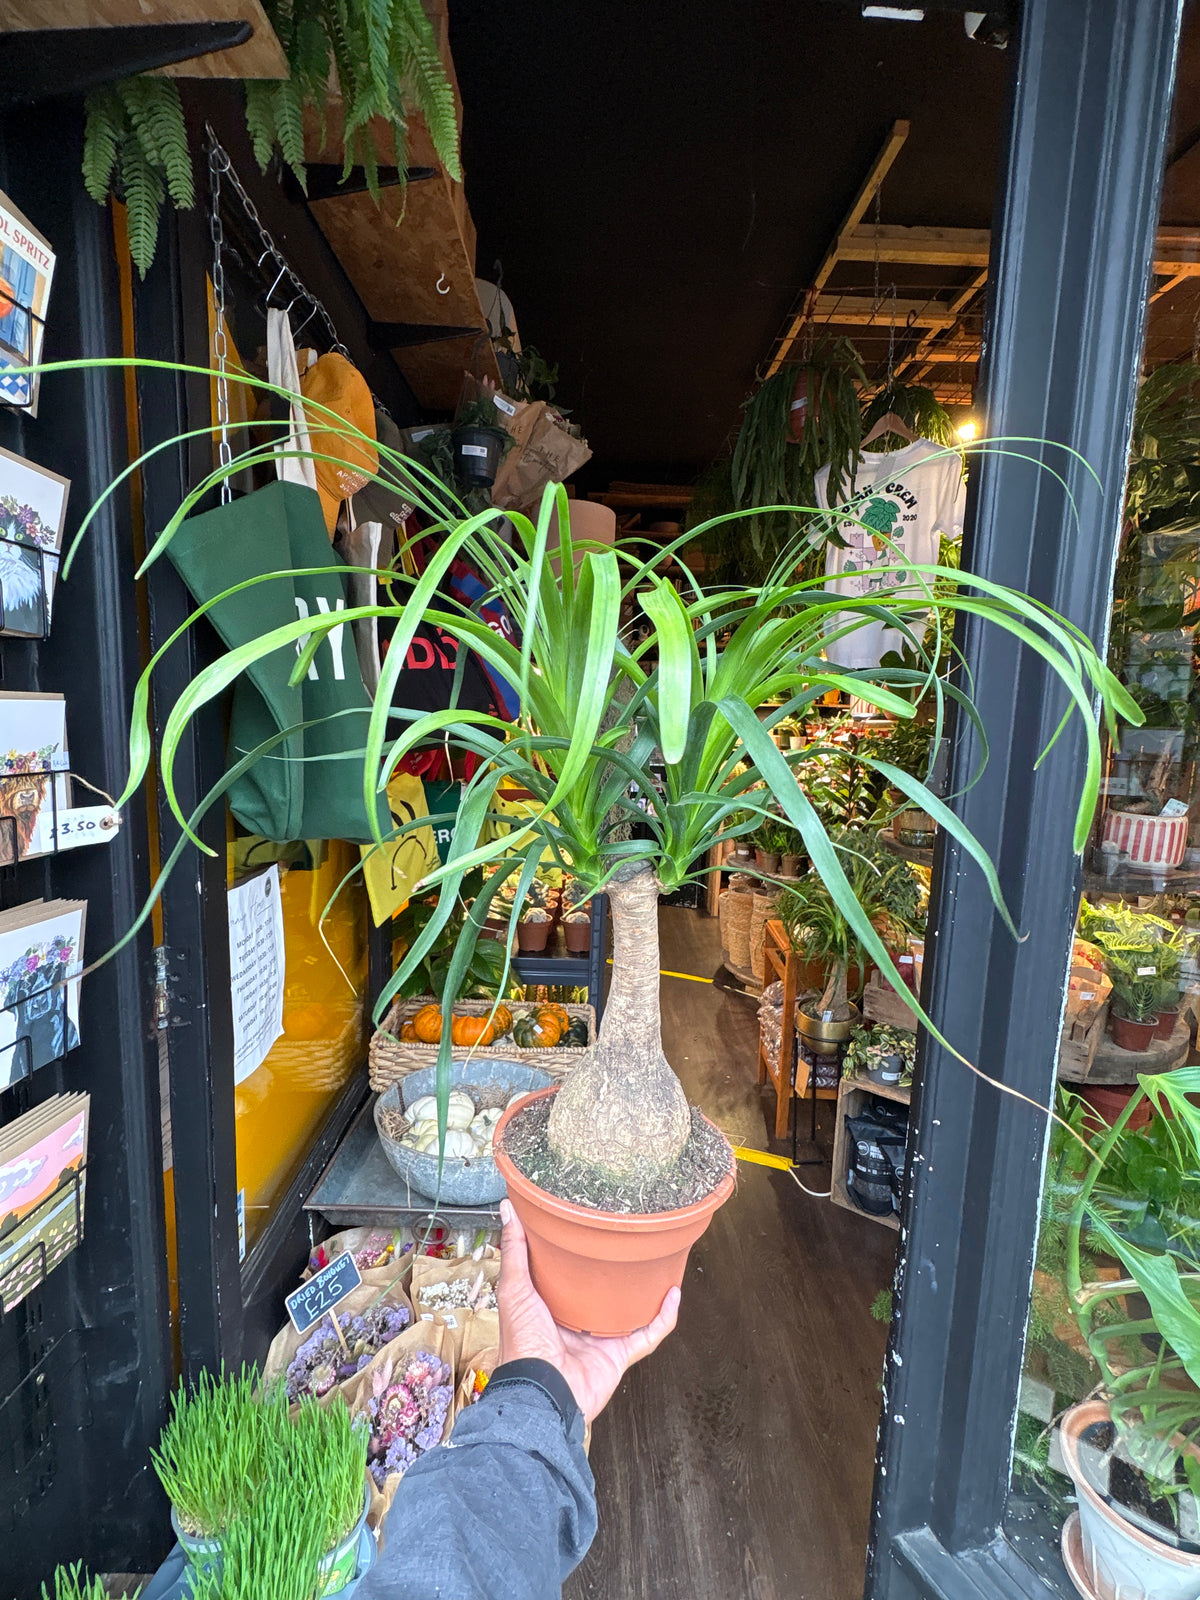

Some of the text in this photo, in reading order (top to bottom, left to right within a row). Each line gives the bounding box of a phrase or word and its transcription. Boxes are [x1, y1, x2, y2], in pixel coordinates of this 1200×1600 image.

[13, 229, 50, 271] SPRITZ
[885, 482, 918, 510] CREW
[902, 513, 918, 522] 2020
[289, 1256, 350, 1310] DRIED BOUQUET
[304, 1275, 343, 1321] £25
